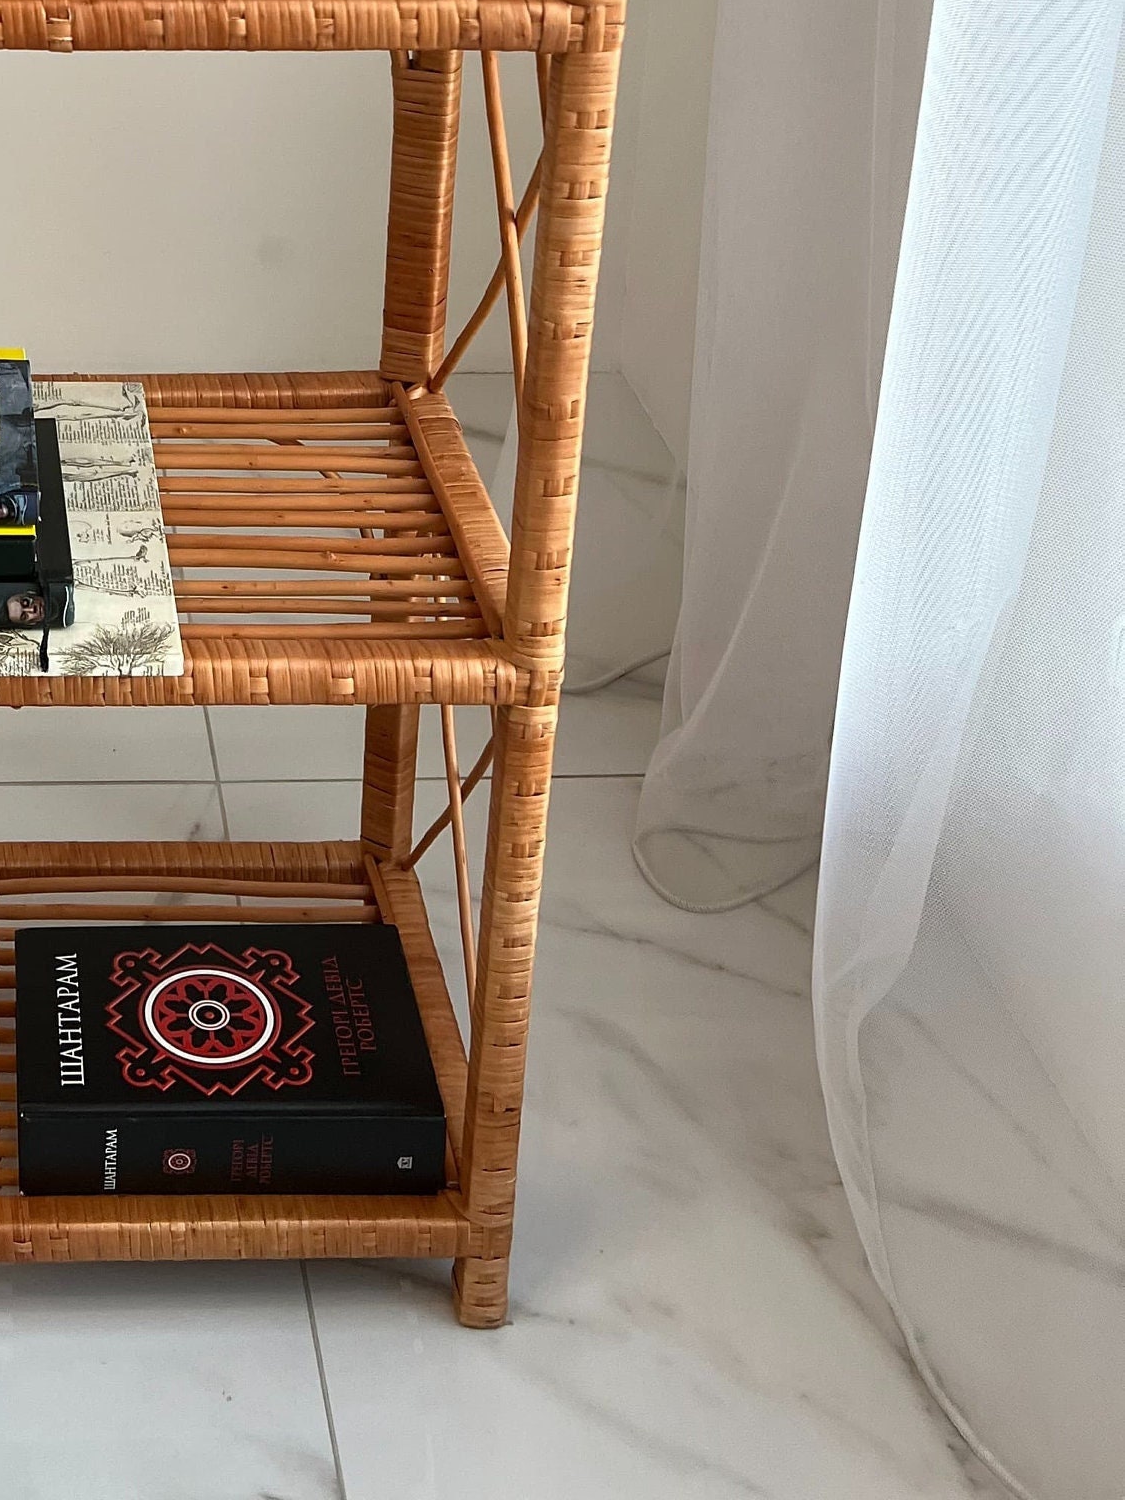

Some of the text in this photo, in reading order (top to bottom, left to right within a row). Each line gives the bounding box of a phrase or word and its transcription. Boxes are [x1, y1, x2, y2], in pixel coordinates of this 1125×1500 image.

[55, 953, 85, 1086] ШАНТАРАМ
[322, 955, 362, 1076] ГРЕГОРІ ДЕВІД
[345, 977, 377, 1051] РОБЕРТС
[104, 1128, 118, 1190] ШАНТАРАМ
